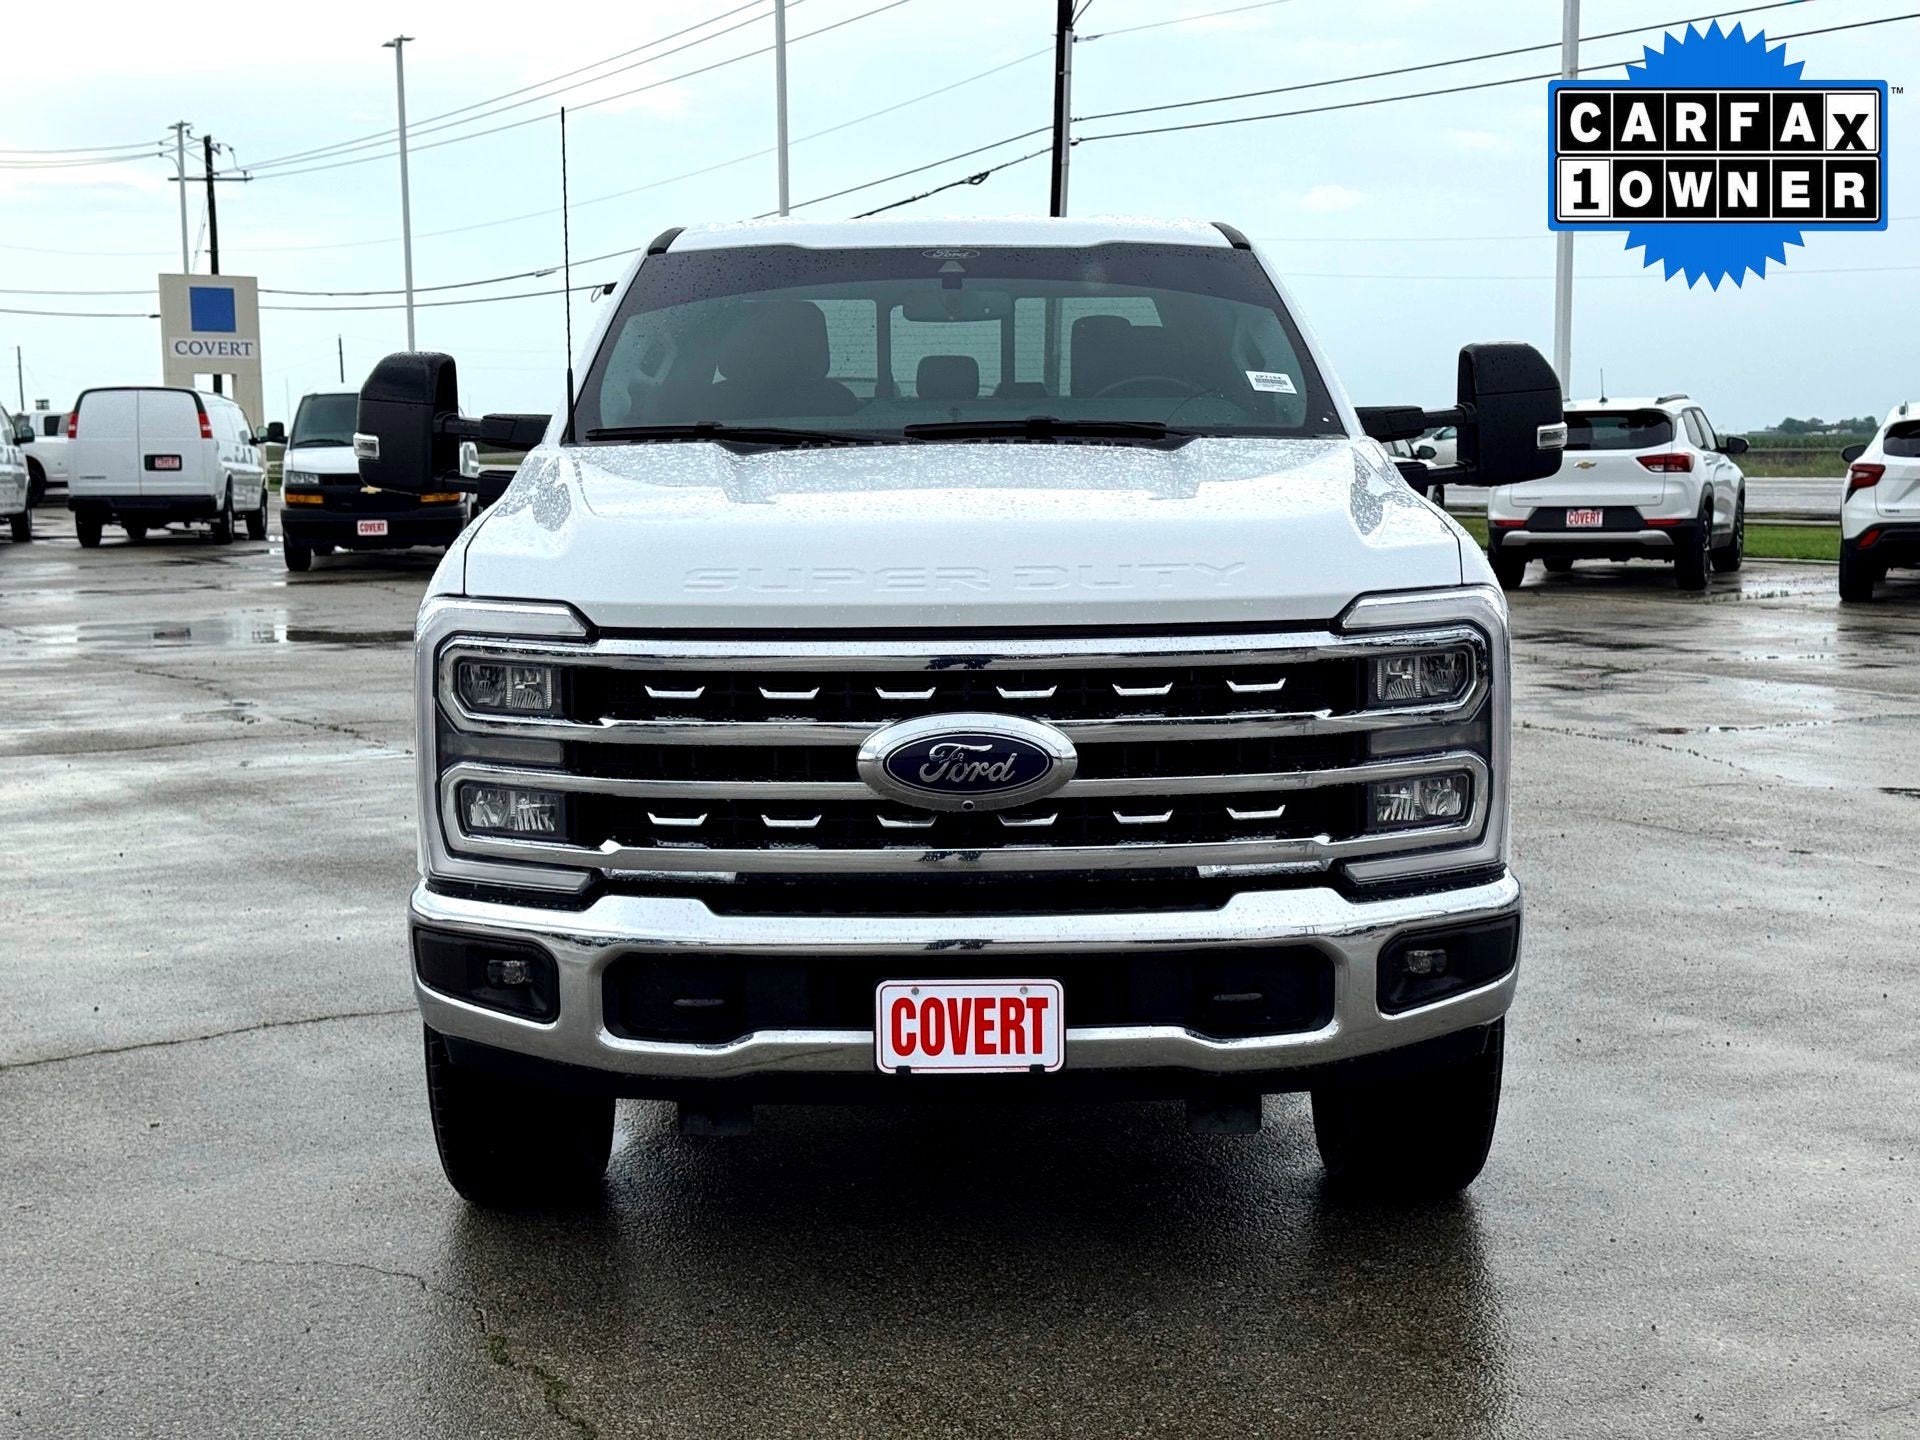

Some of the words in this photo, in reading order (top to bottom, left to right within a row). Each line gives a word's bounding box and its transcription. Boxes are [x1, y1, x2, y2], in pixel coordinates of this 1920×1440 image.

[932, 249, 970, 258] Ford
[174, 340, 253, 356] COVERT
[1568, 511, 1600, 524] COVERT
[360, 522, 385, 533] COVERT
[683, 566, 991, 592] SUPER
[1014, 562, 1246, 590] DUTY
[919, 743, 1017, 782] Ford
[891, 997, 1048, 1056] COVERT
